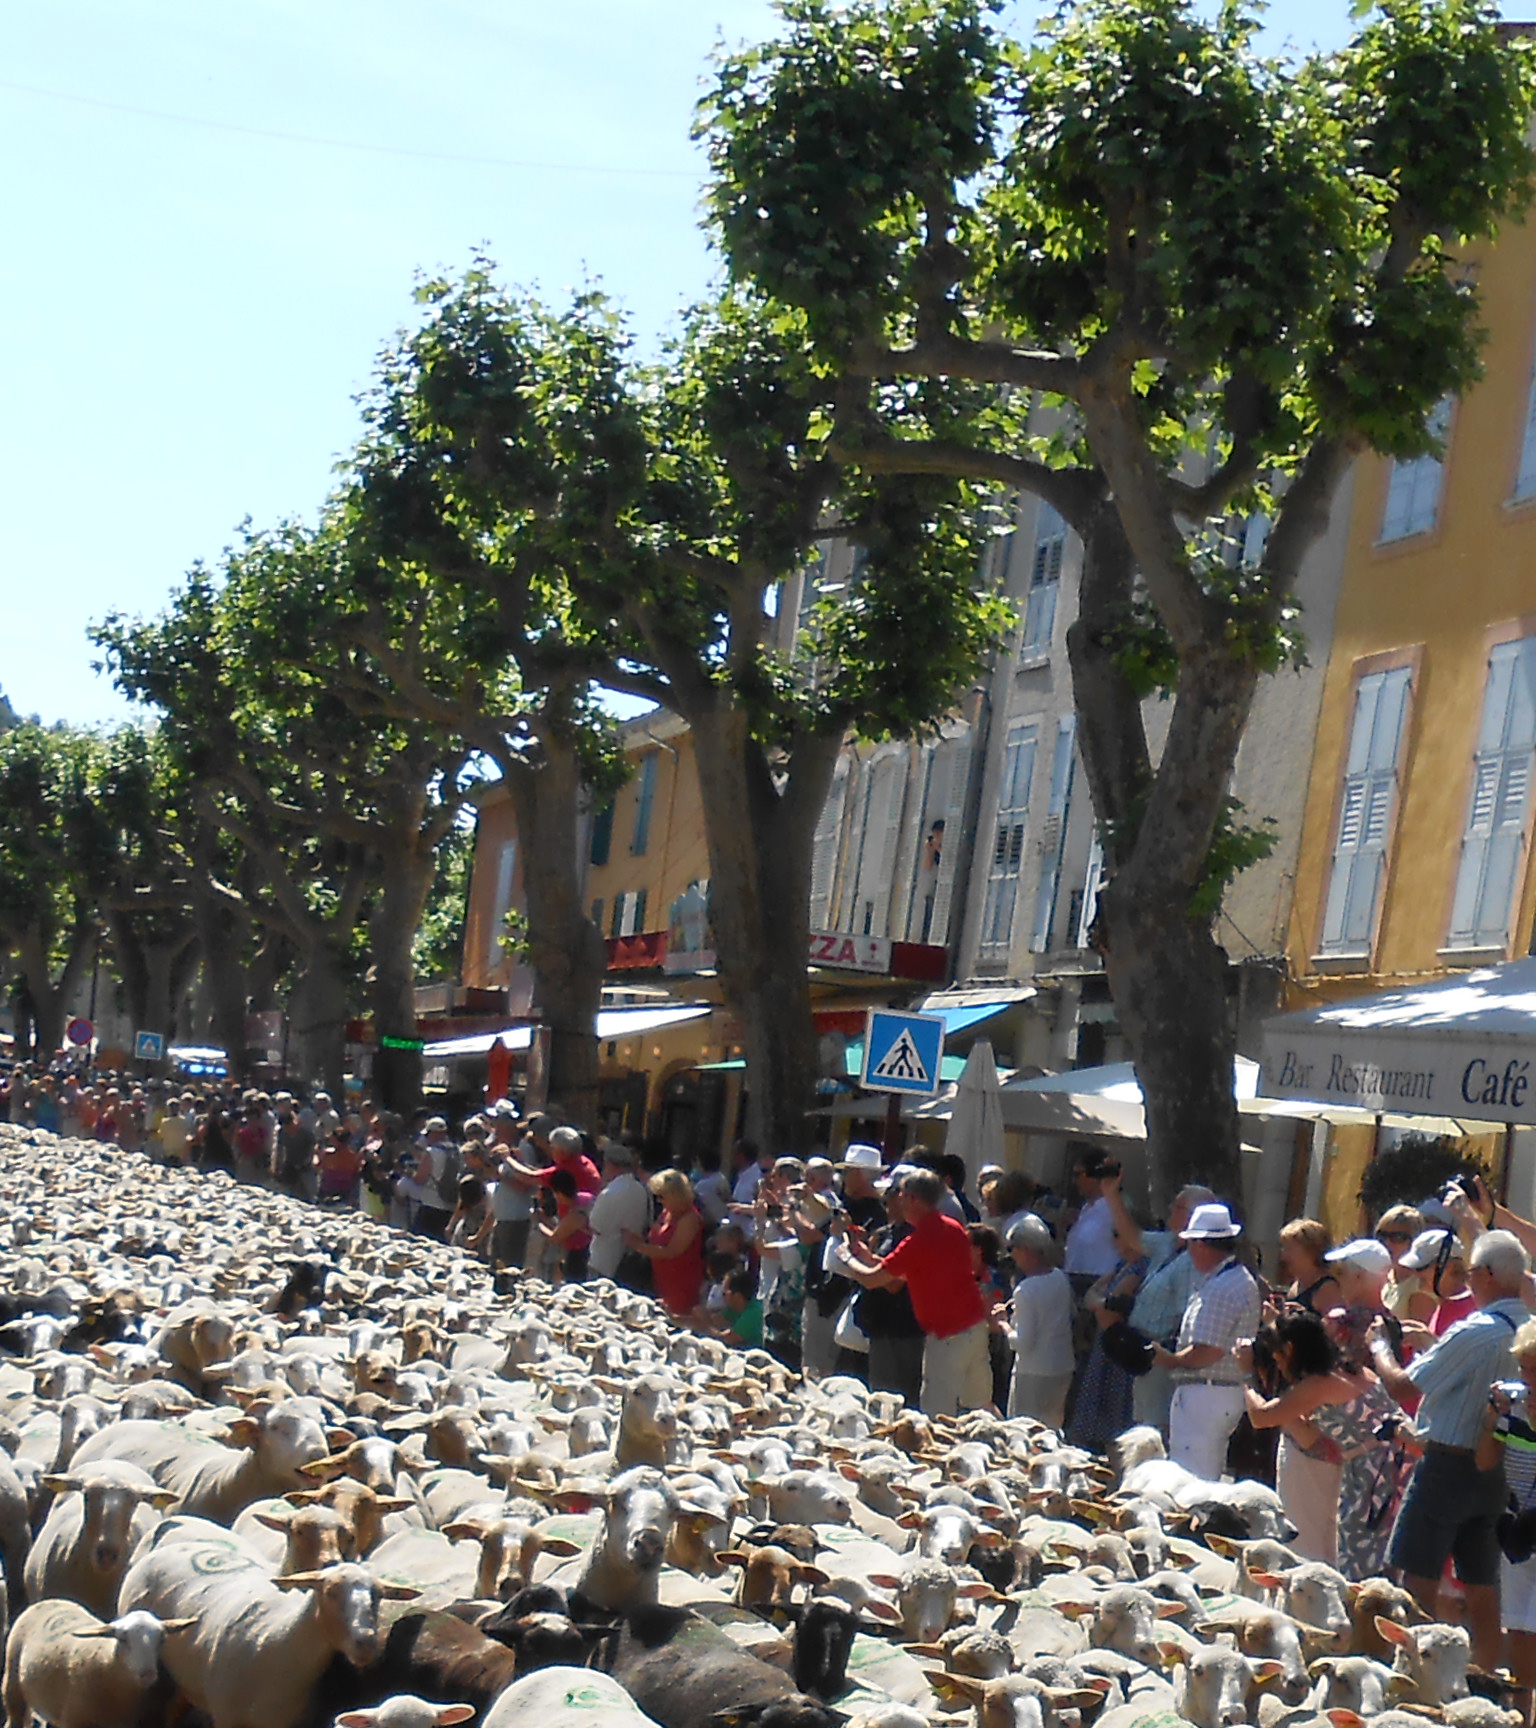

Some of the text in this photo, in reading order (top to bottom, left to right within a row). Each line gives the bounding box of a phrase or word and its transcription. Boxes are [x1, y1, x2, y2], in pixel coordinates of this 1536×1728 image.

[1279, 1051, 1314, 1089] Bar
[1326, 1053, 1435, 1100] Restaurant
[1461, 1058, 1531, 1108] Café
